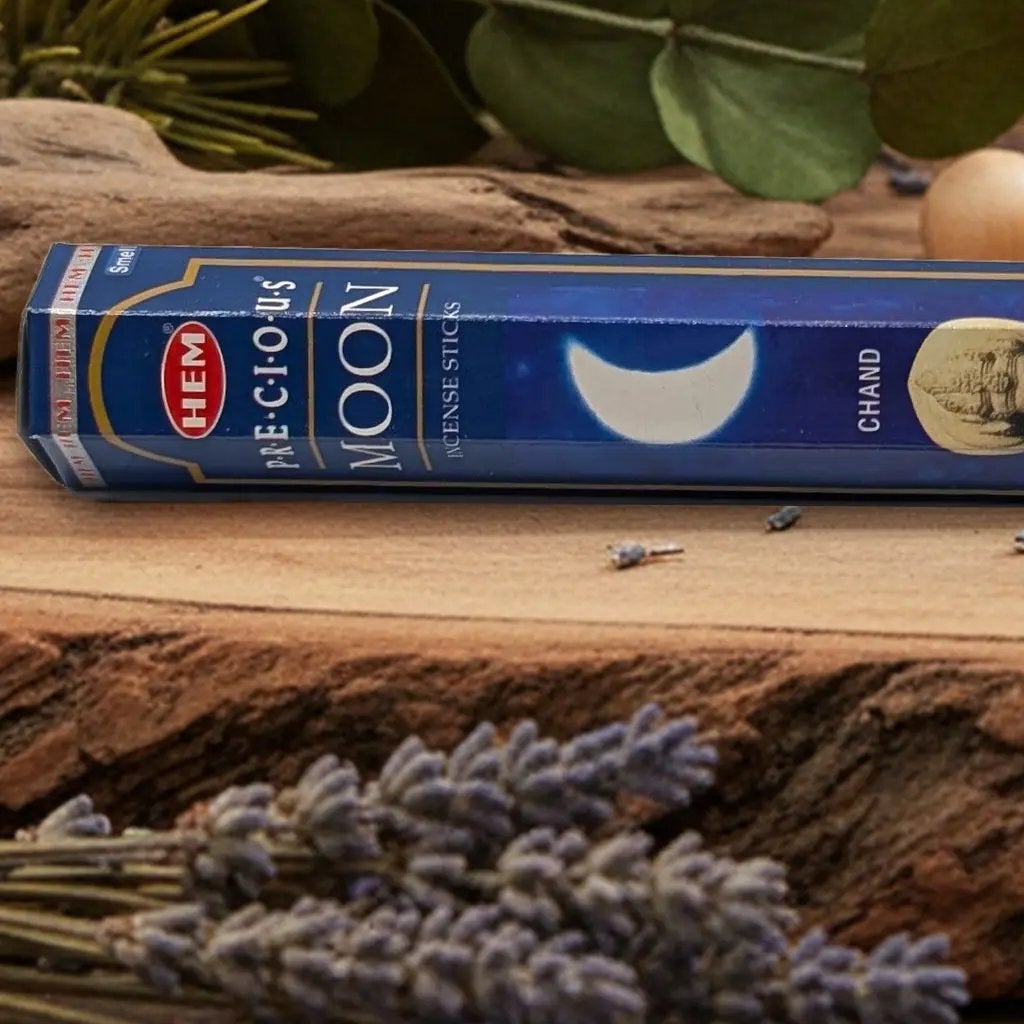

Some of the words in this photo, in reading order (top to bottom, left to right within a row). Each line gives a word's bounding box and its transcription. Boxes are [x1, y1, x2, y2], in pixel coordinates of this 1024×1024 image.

[60, 267, 84, 303] HEM
[338, 282, 402, 471] MOON
[442, 301, 461, 372] STICKS
[181, 332, 207, 429] HEM
[442, 377, 464, 459] INCENSE
[857, 348, 881, 433] CHAND
